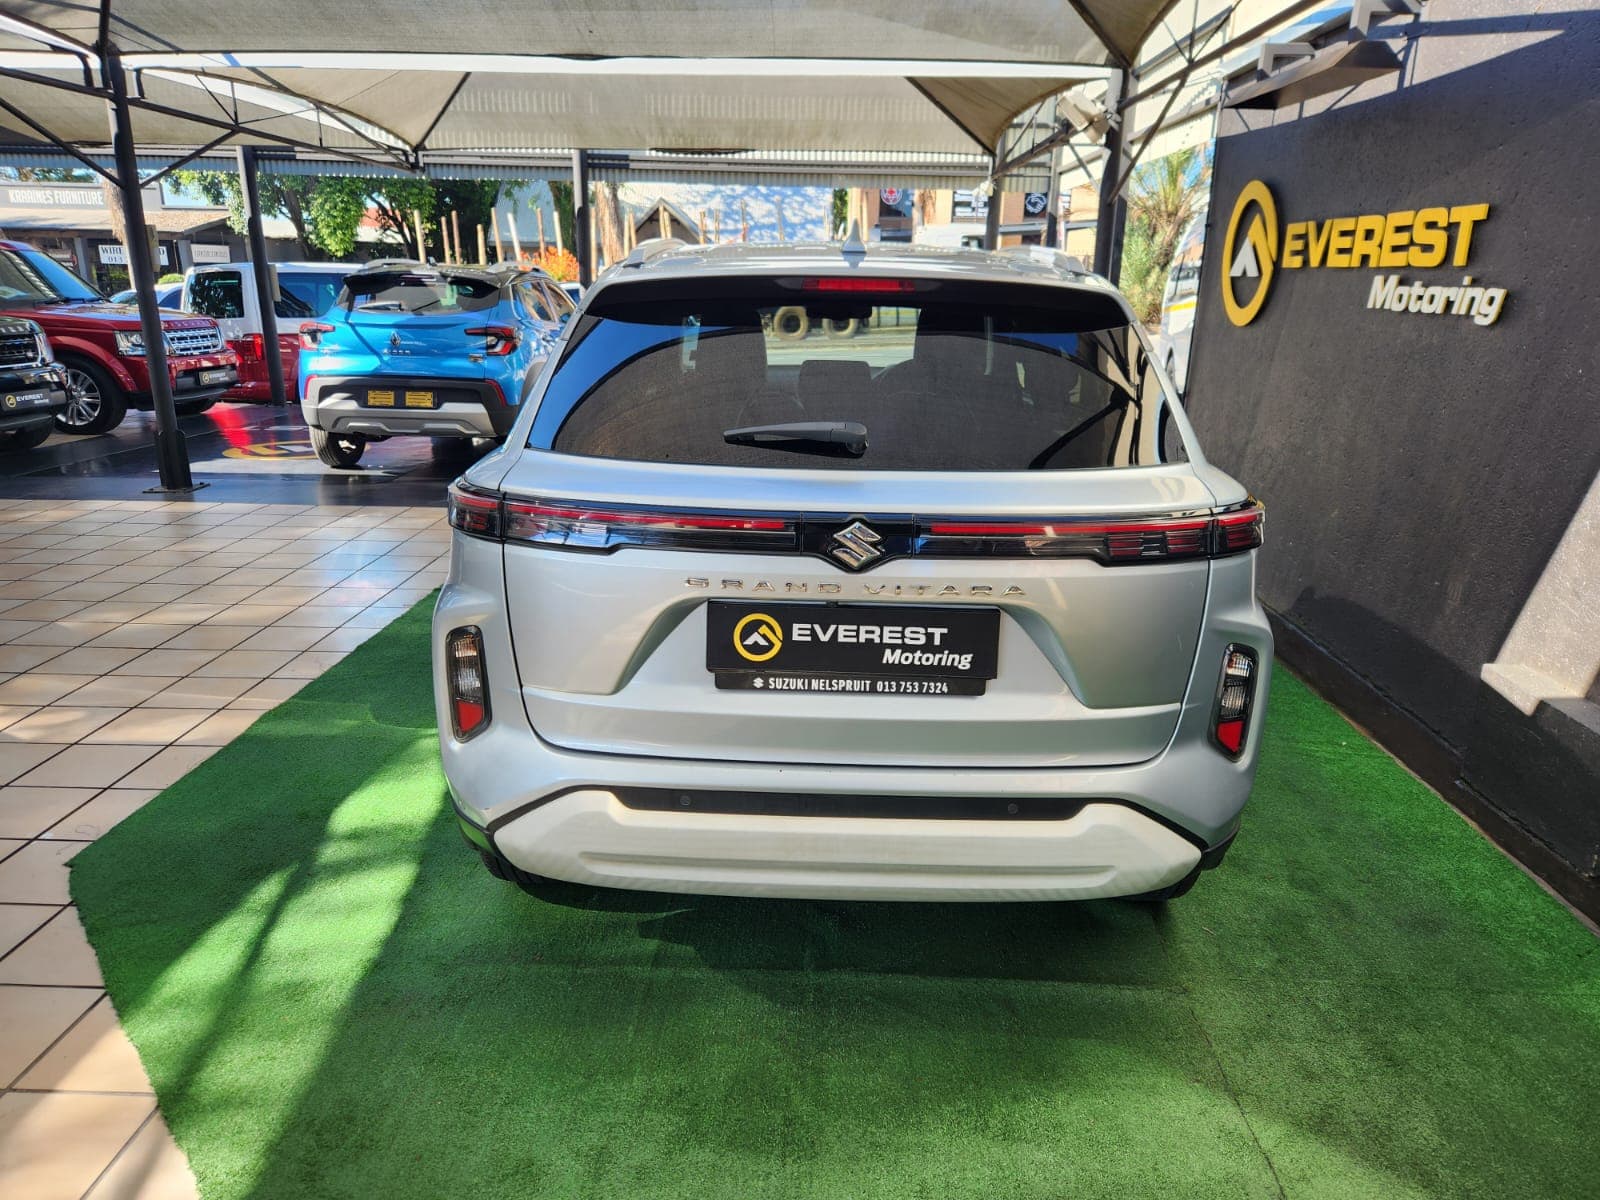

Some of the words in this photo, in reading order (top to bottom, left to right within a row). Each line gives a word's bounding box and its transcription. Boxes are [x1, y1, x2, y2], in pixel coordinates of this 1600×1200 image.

[55, 190, 103, 205] FURNITURE
[1281, 203, 1490, 269] EVEREST
[1367, 274, 1509, 326] Motoring
[16, 393, 43, 402] EVEREST
[685, 577, 842, 593] GRAND
[863, 583, 1026, 596] VITARA
[791, 622, 949, 647] EVEREST
[881, 648, 973, 670] Motoring
[768, 677, 809, 691] SUZUKI
[811, 678, 871, 692] NELSPRUIT
[876, 680, 898, 693] 013
[899, 681, 920, 693] 753
[921, 681, 948, 694] 7324
